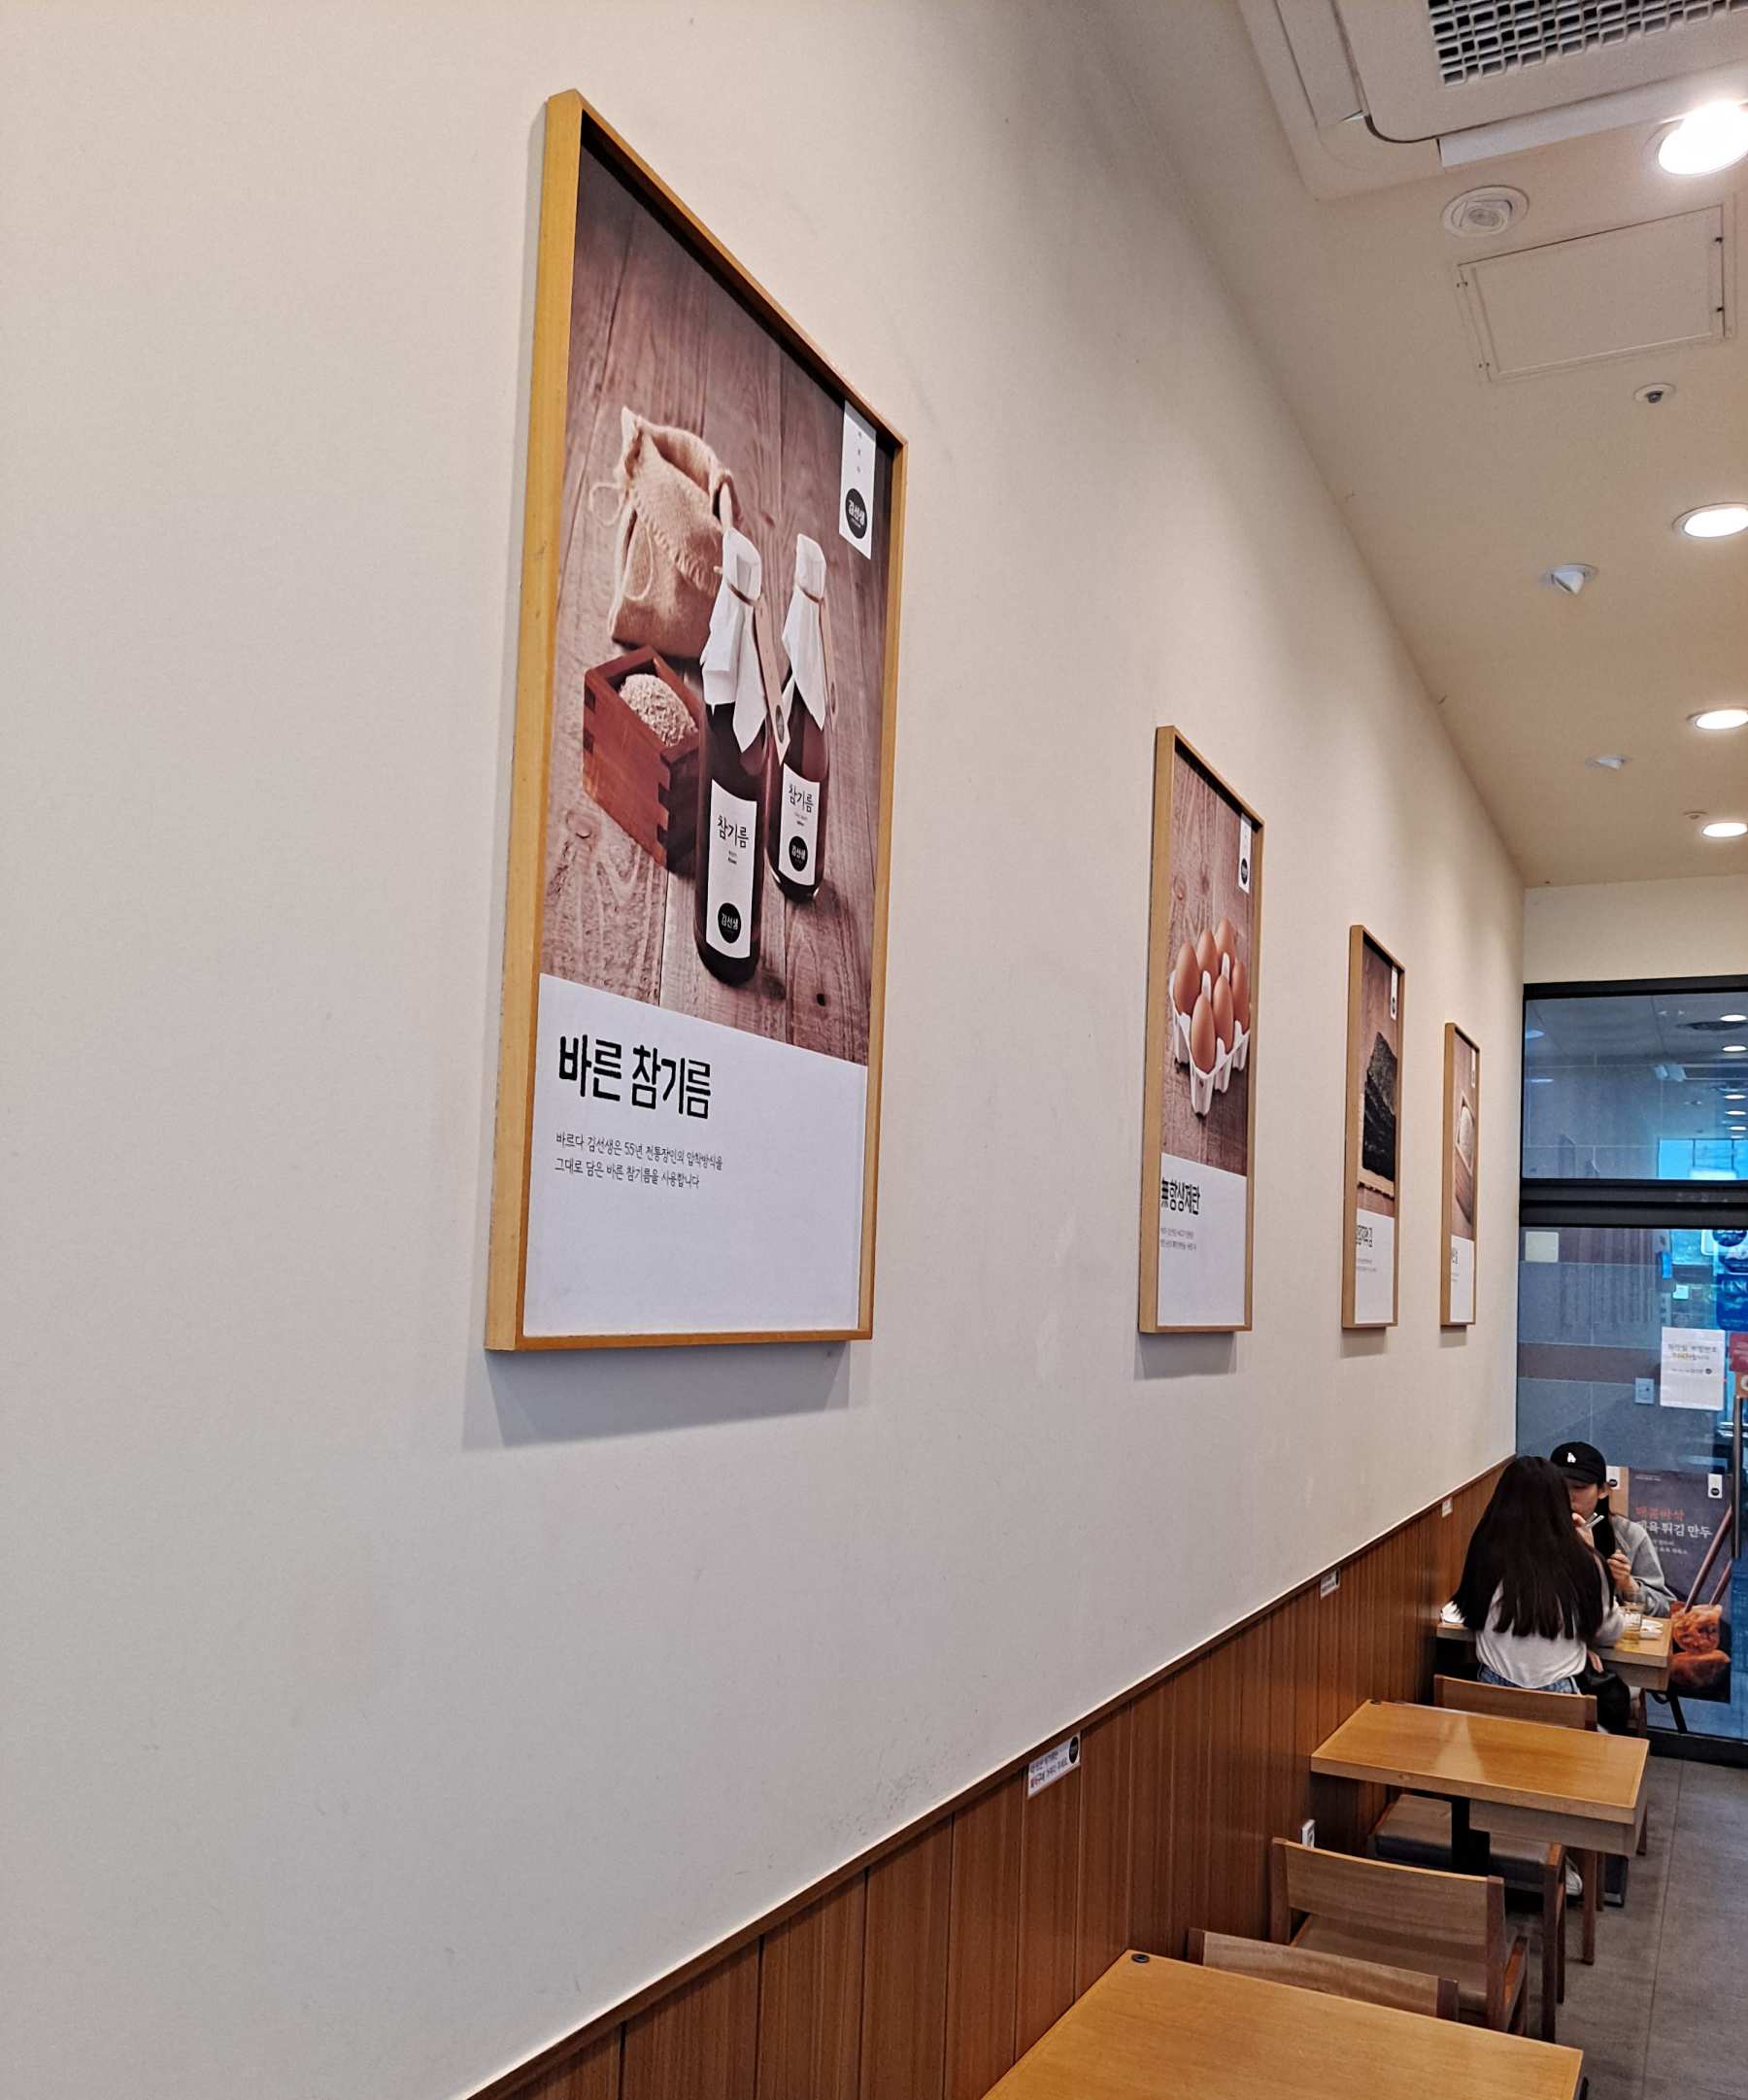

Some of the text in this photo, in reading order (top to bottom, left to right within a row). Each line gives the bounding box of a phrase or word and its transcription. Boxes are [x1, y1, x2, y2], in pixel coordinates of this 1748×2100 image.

[789, 784, 814, 813] 참기름
[718, 815, 749, 848] 참기름
[558, 1034, 712, 1119] 바른 참기름
[555, 1132, 585, 1148] 바르다
[587, 1136, 622, 1156] 김선생은
[624, 1141, 643, 1160] 55년
[555, 1158, 700, 1189] 그대로 담은 바른 참기름을 사용합니다
